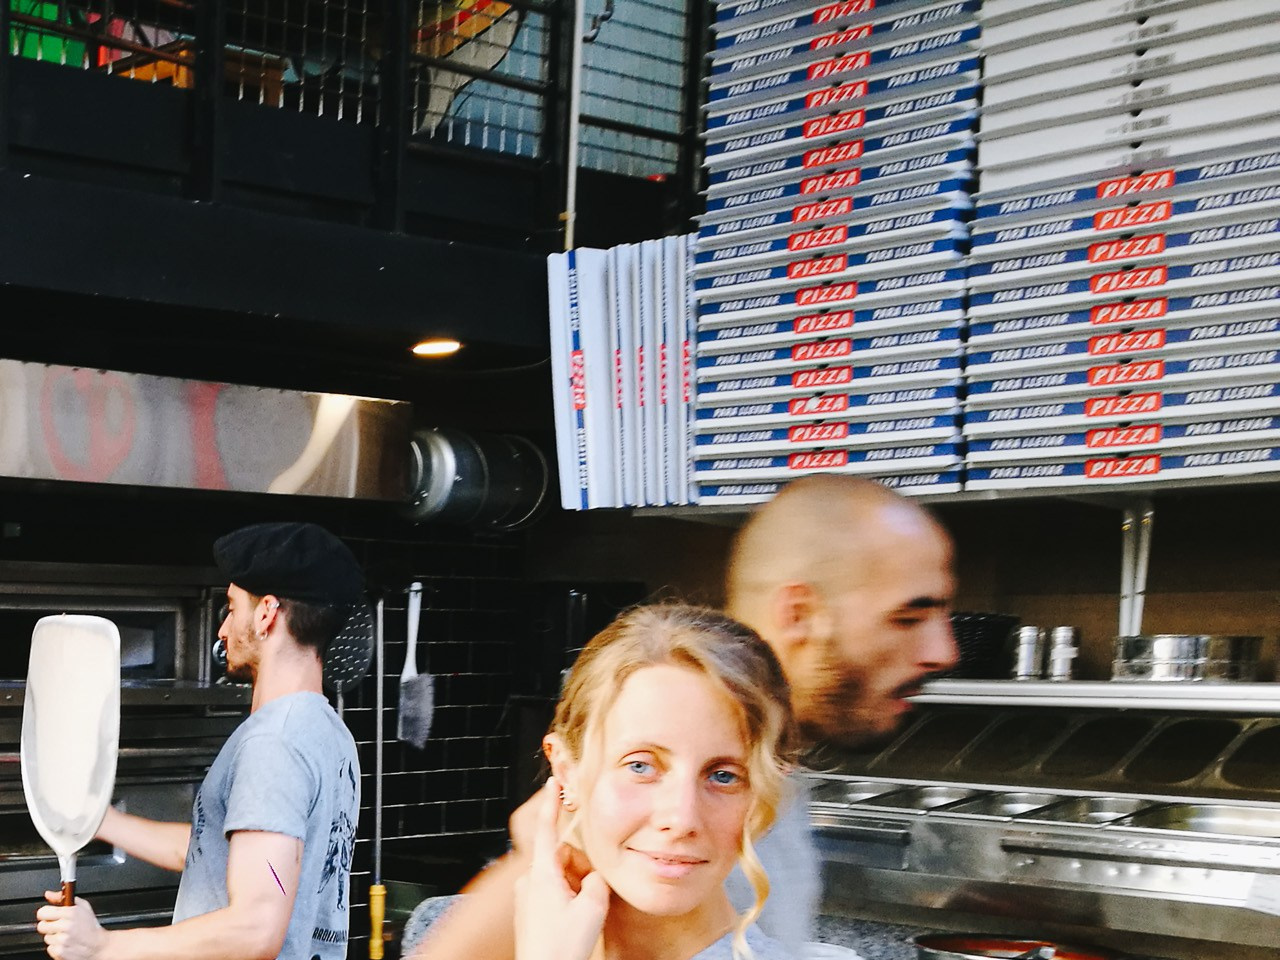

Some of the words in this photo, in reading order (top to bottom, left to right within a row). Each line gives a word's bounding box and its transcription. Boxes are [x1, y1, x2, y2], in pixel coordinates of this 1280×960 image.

[817, 0, 870, 23] PIZZA
[729, 83, 754, 96] PARA
[754, 74, 791, 90] LLEVAR
[813, 54, 866, 79] PIZZA
[890, 43, 919, 57] PARA
[920, 33, 961, 50] LLEVAR
[726, 111, 751, 124] PARA
[752, 102, 788, 118] LLEVAR
[811, 84, 863, 107] PIZZA
[888, 73, 917, 88] PARA
[917, 63, 959, 81] LLEVAR
[724, 138, 750, 151] PARA
[750, 129, 786, 146] LLEVAR
[808, 112, 861, 137] PIZZA
[885, 102, 914, 117] PARA
[914, 92, 956, 110] LLEVAR
[727, 167, 751, 180] PARA
[751, 159, 786, 174] LLEVAR
[808, 143, 860, 166] PIZZA
[882, 132, 910, 147] PARA
[911, 123, 951, 141] LLEVAR
[725, 195, 749, 207] PARA
[749, 187, 784, 202] LLEVAR
[805, 172, 856, 194] PIZZA
[879, 162, 907, 175] PARA
[908, 153, 948, 169] LLEVAR
[1000, 199, 1031, 214] PARA
[1032, 191, 1076, 208] LLEVAR
[1103, 173, 1167, 197] PIZZA
[1199, 162, 1235, 179] PARA
[717, 222, 741, 233] PARA
[742, 214, 776, 229] LLEVAR
[797, 201, 848, 220] PIZZA
[871, 192, 899, 205] PARA
[899, 184, 939, 200] LLEVAR
[996, 228, 1028, 242] PARA
[1028, 220, 1073, 237] LLEVAR
[1100, 205, 1165, 229] PIZZA
[1196, 194, 1233, 211] PARA
[713, 248, 737, 259] PARA
[738, 241, 772, 255] LLEVAR
[792, 229, 843, 249] PIZZA
[866, 220, 894, 233] PARA
[894, 212, 934, 228] LLEVAR
[991, 259, 1022, 273] PARA
[1023, 252, 1067, 269] LLEVAR
[1093, 238, 1158, 262] PIZZA
[1189, 228, 1226, 244] PARA
[1226, 219, 1279, 239] LLEVAR
[713, 276, 737, 286] PARA
[737, 270, 772, 282] LLEVAR
[791, 258, 842, 277] PIZZA
[865, 250, 893, 262] PARA
[893, 243, 932, 257] LLEVAR
[993, 289, 1024, 302] PARA
[1024, 282, 1069, 298] LLEVAR
[1094, 270, 1161, 293] PIZZA
[1191, 261, 1228, 276] PARA
[1228, 253, 1280, 271] LLEVAR
[719, 301, 744, 312] PARA
[744, 295, 780, 308] LLEVAR
[800, 285, 852, 304] PIZZA
[876, 278, 905, 290] PARA
[905, 271, 946, 286] LLEVAR
[993, 319, 1024, 333] PARA
[1024, 313, 1069, 329] LLEVAR
[1096, 301, 1160, 322] PIZZA
[1191, 293, 1228, 308] PARA
[1228, 286, 1280, 303] LLEVAR
[717, 328, 742, 338] PARA
[742, 323, 777, 335] LLEVAR
[798, 313, 850, 332] PIZZA
[873, 307, 902, 319] PARA
[902, 301, 943, 316] LLEVAR
[716, 355, 740, 365] PARA
[741, 350, 776, 362] LLEVAR
[796, 341, 849, 360] PIZZA
[871, 336, 899, 348] PARA
[899, 330, 940, 344] LLEVAR
[990, 350, 1021, 362] PARA
[1022, 344, 1066, 358] LLEVAR
[1093, 333, 1157, 354] PIZZA
[1190, 326, 1226, 339] PARA
[1226, 320, 1278, 335] LLEVAR
[716, 381, 741, 391] PARA
[741, 377, 776, 389] LLEVAR
[796, 369, 849, 386] PIZZA
[871, 364, 899, 376] PARA
[900, 359, 940, 373] LLEVAR
[991, 379, 1022, 392] PARA
[1022, 374, 1067, 388] LLEVAR
[1093, 364, 1158, 384] PIZZA
[1188, 357, 1224, 372] PARA
[1225, 351, 1276, 368] LLEVAR
[714, 407, 738, 417] PARA
[738, 404, 773, 415] LLEVAR
[867, 392, 896, 404] PARA
[896, 388, 936, 402] LLEVAR
[988, 409, 1019, 421] PARA
[1020, 405, 1064, 418] LLEVAR
[1089, 394, 1156, 415] PIZZA
[1186, 390, 1222, 404] PARA
[1222, 384, 1274, 400] LLEVAR
[713, 433, 737, 443] PARA
[737, 430, 773, 441] LLEVAR
[792, 425, 845, 441] PIZZA
[867, 421, 894, 433] PARA
[895, 417, 934, 430] LLEVAR
[990, 439, 1021, 450] PARA
[1022, 435, 1065, 447] LLEVAR
[1091, 427, 1155, 446] PIZZA
[1185, 422, 1221, 435] PARA
[1221, 418, 1272, 432] LLEVAR
[713, 460, 737, 469] PARA
[737, 457, 772, 467] LLEVAR
[791, 452, 844, 469] PIZZA
[866, 449, 894, 460] PARA
[894, 445, 934, 458] LLEVAR
[989, 468, 1020, 478] PARA
[1020, 465, 1063, 476] LLEVAR
[1091, 458, 1154, 476] PIZZA
[1184, 453, 1220, 466] PARA
[1220, 449, 1271, 464] LLEVAR
[718, 486, 742, 494] PARA
[742, 484, 777, 493] LLEVAR
[900, 474, 939, 486] LLEVAR
